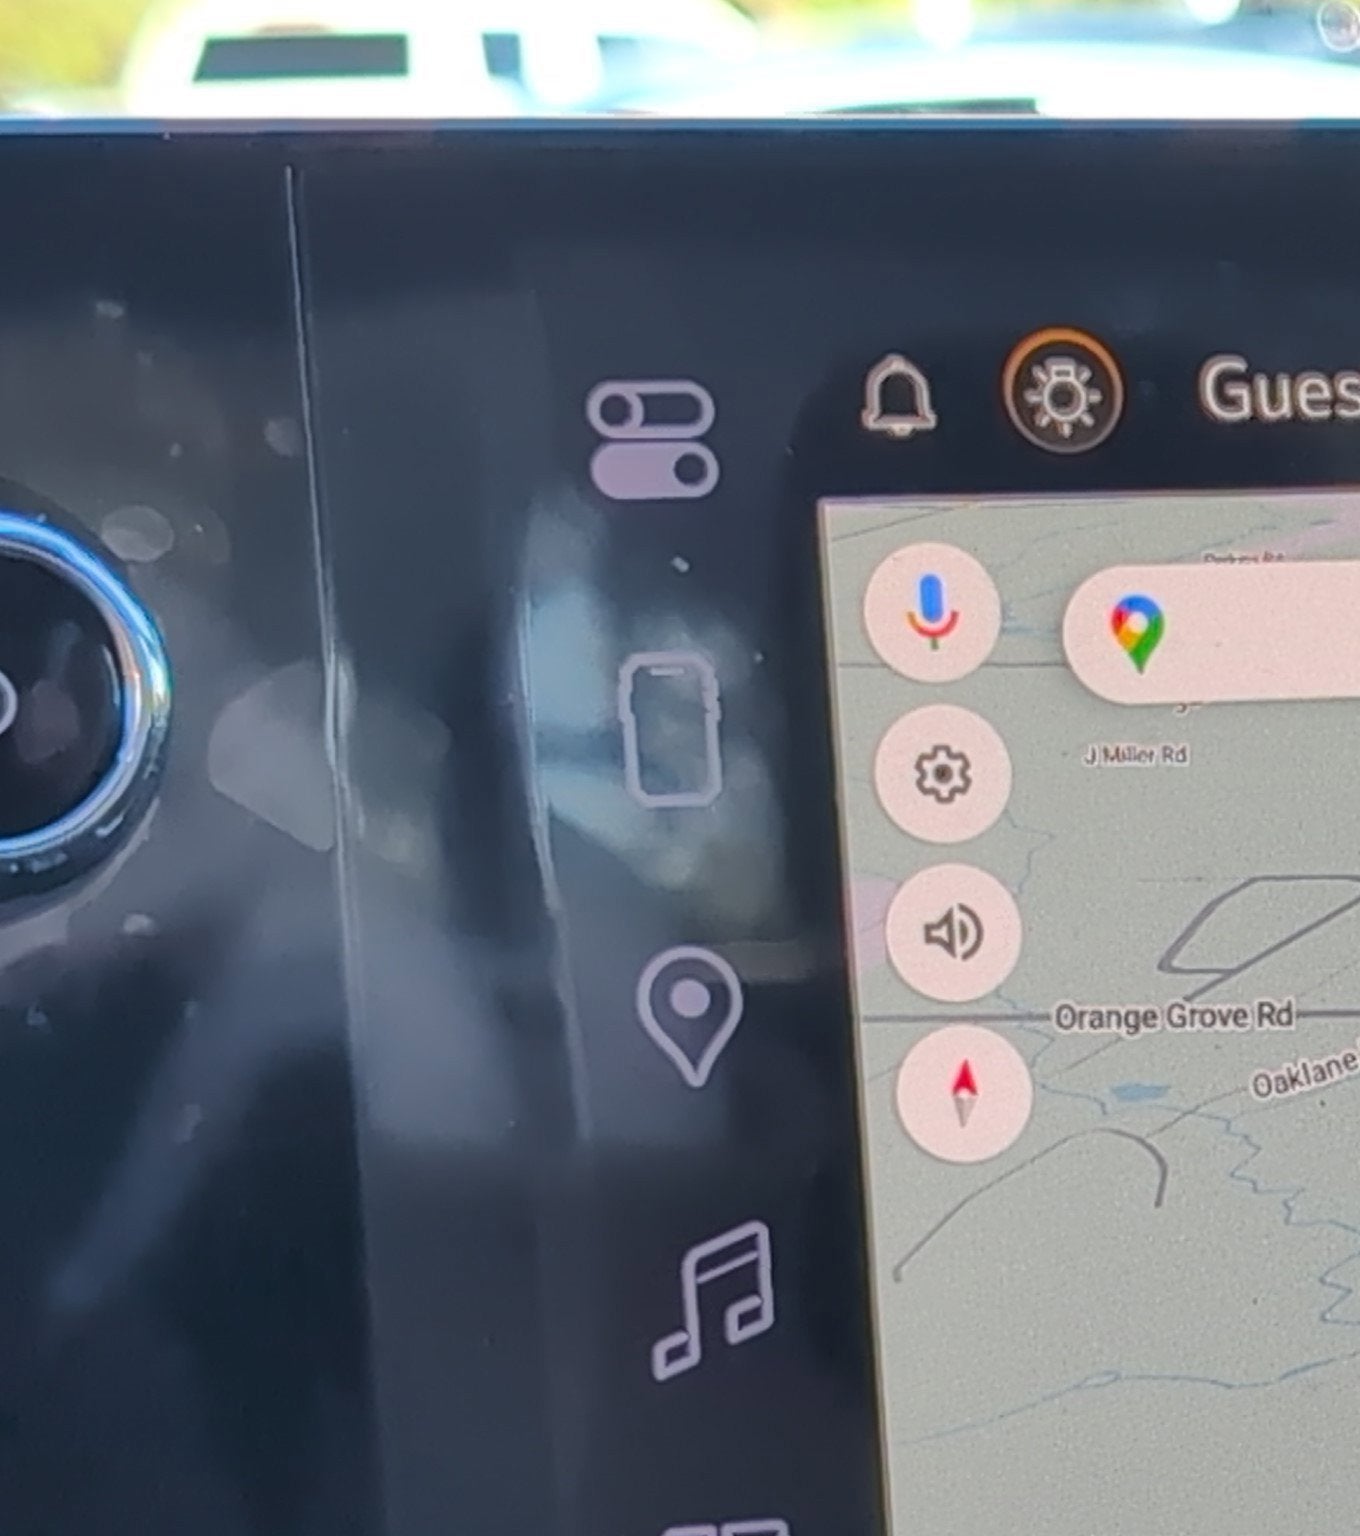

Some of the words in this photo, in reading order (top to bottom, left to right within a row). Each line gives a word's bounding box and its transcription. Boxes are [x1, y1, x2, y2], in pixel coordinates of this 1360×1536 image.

[1084, 746, 1098, 766] J
[1103, 744, 1156, 765] Miller
[1161, 744, 1188, 764] Rd
[1054, 1003, 1159, 1035] Orange
[1166, 1003, 1251, 1031] Grove
[1258, 1001, 1295, 1028] Rd
[1251, 1050, 1358, 1100] Oaklane
